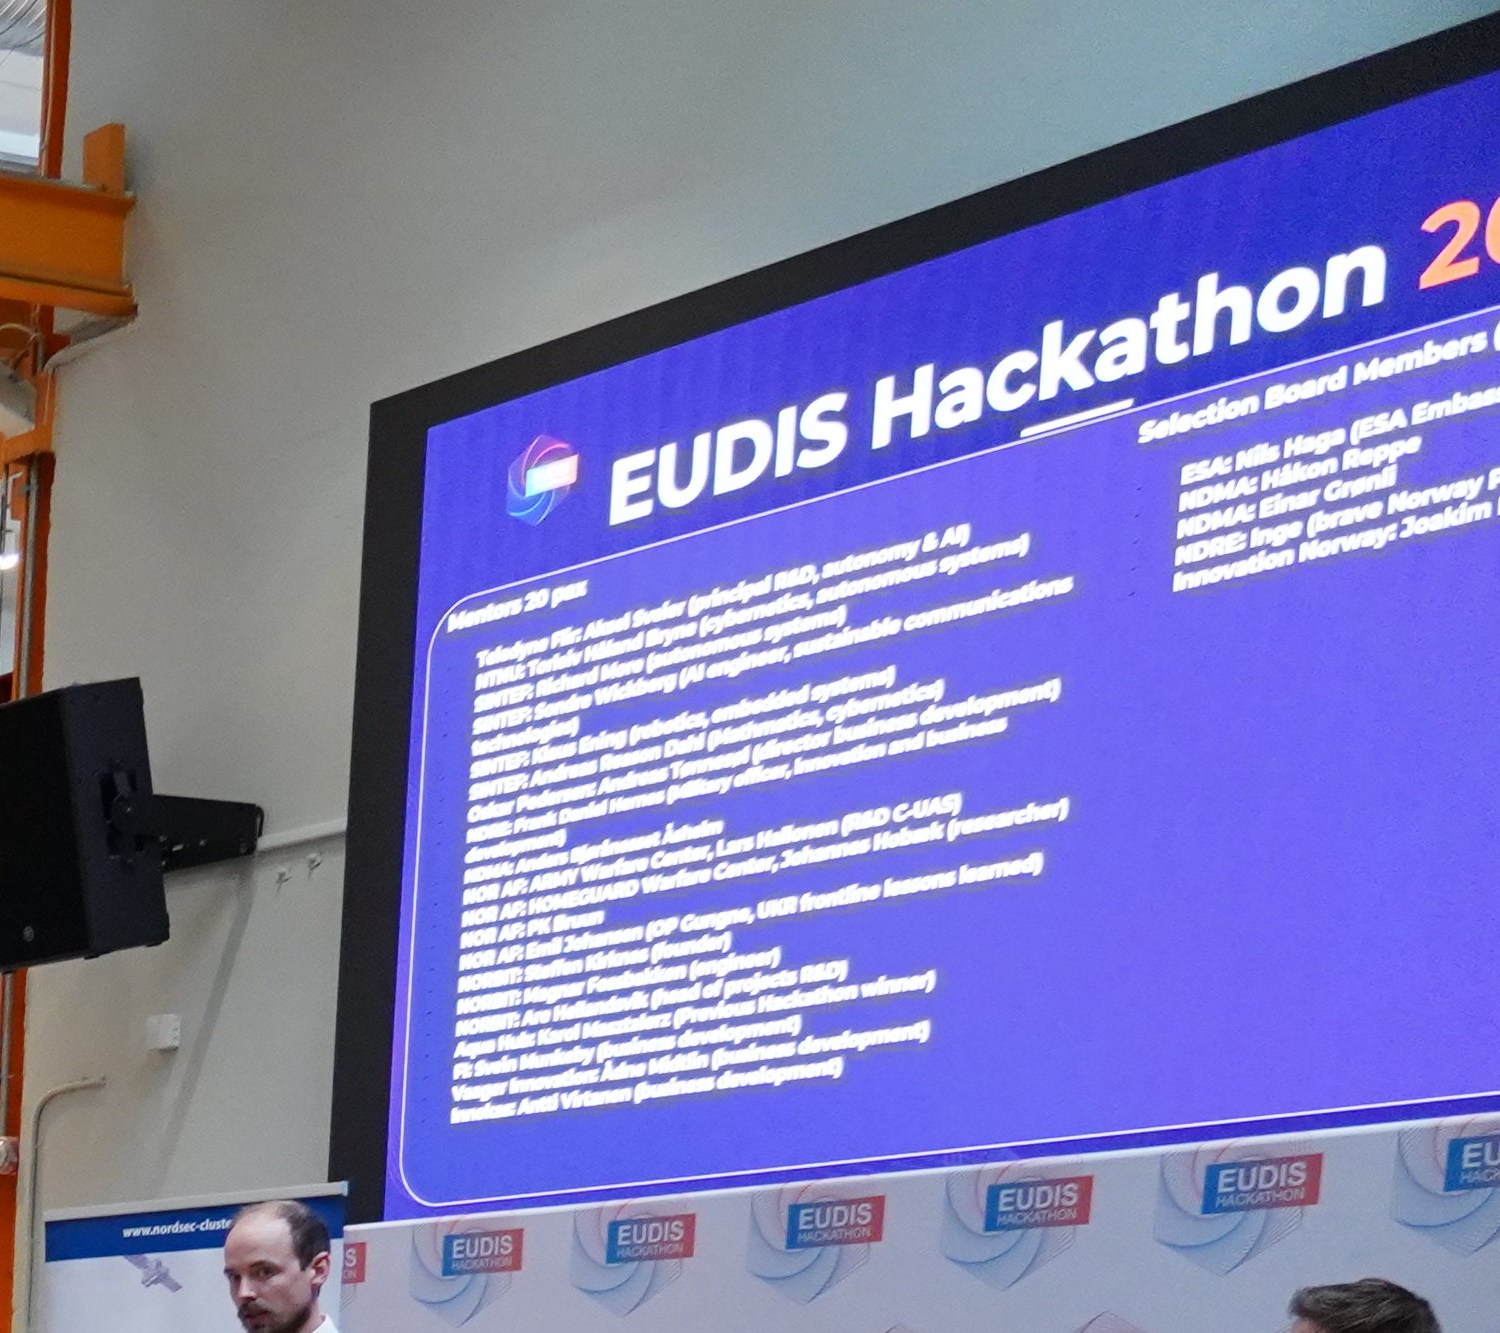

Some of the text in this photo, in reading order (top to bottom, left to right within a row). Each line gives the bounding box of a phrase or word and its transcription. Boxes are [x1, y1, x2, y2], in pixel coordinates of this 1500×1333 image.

[609, 394, 847, 525] EUDIS
[874, 242, 1386, 447] Hackathon
[1138, 332, 1487, 443] Selection Board Members
[1181, 457, 1232, 485] ESA:
[1284, 428, 1346, 458] Haga
[1350, 409, 1407, 445] (ESA
[1179, 476, 1258, 512] NDMA:
[1177, 504, 1256, 539] NDMA:
[1259, 489, 1321, 518] Einar
[1250, 521, 1303, 548] Inge
[1307, 501, 1383, 538] (brave
[1387, 476, 1484, 514] Norway
[1173, 502, 1492, 592] Innovation Norway: Joakim
[904, 577, 1073, 631] communications
[947, 798, 1069, 842] (researcher)
[1217, 1162, 1308, 1193] EUDIS
[998, 1184, 1079, 1213] EUDIS
[1215, 1187, 1305, 1207] HACKATHON
[122, 1218, 234, 1238] www.nordsec-cluste
[798, 1203, 873, 1230] EUDIS
[997, 1205, 1078, 1225] HACKATHON
[453, 1235, 513, 1260] EUDIS
[617, 1220, 684, 1246] EUDIS
[797, 1224, 872, 1242] HACKATHON
[451, 1256, 513, 1272] HACKATHON
[616, 1241, 684, 1258] HACKATHON
